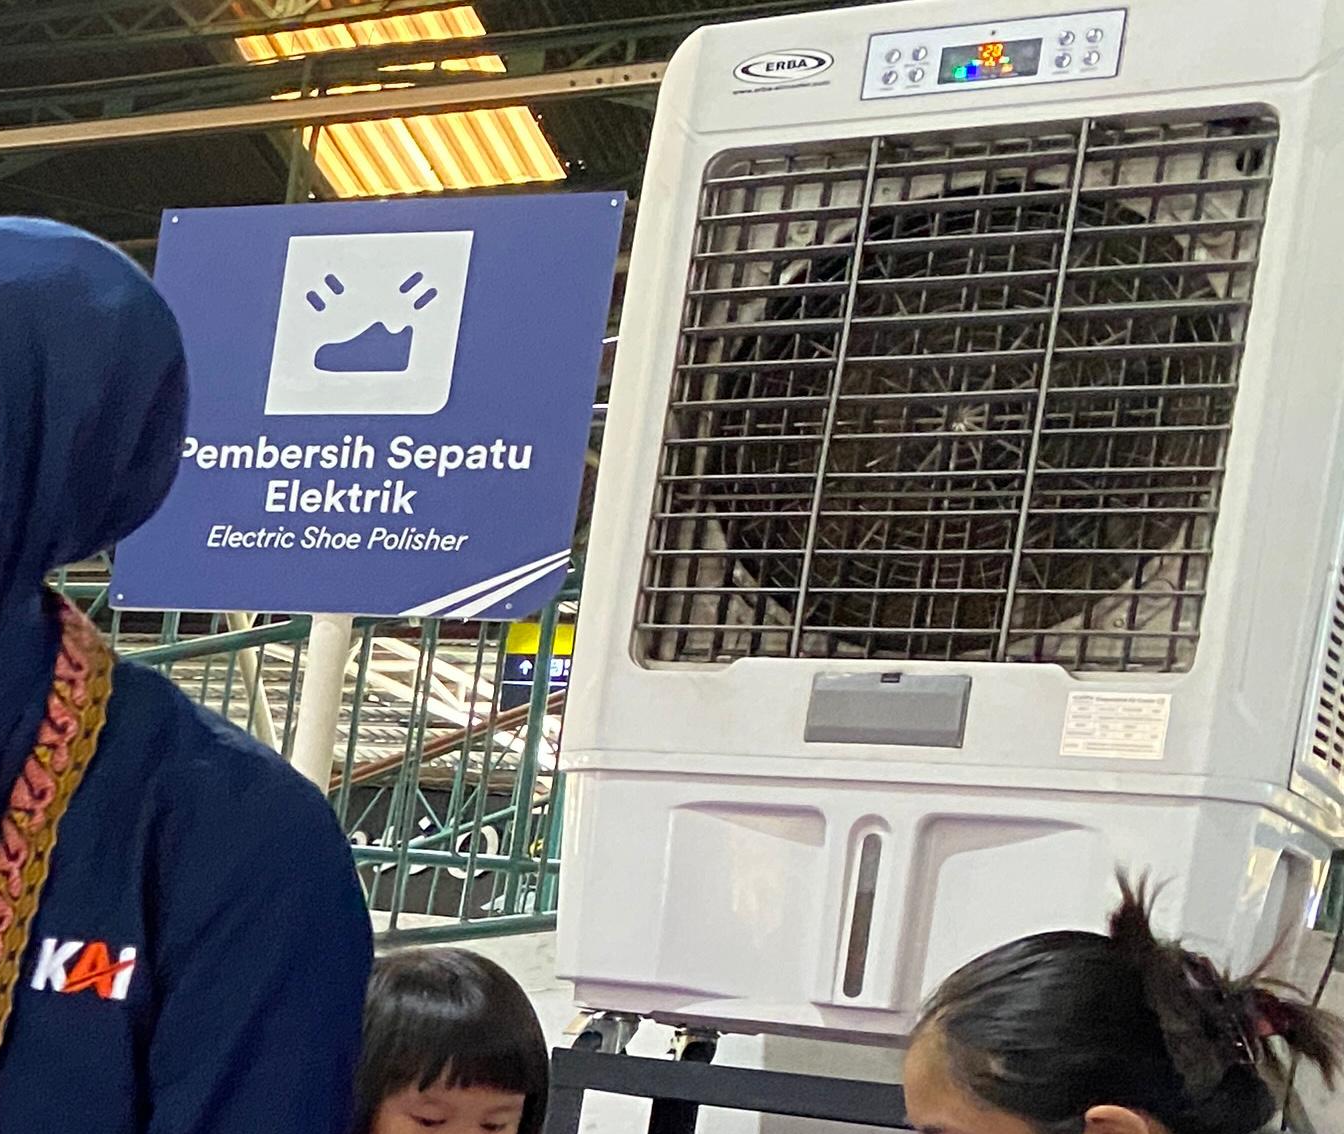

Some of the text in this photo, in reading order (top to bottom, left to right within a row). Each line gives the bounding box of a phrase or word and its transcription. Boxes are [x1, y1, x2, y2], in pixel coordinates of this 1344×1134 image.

[765, 58, 808, 73] ERBA
[387, 435, 532, 477] Sepatu
[265, 479, 417, 515] Elektrik
[206, 524, 468, 552] Electric Shoe Polisher
[30, 938, 137, 1001] KAI
